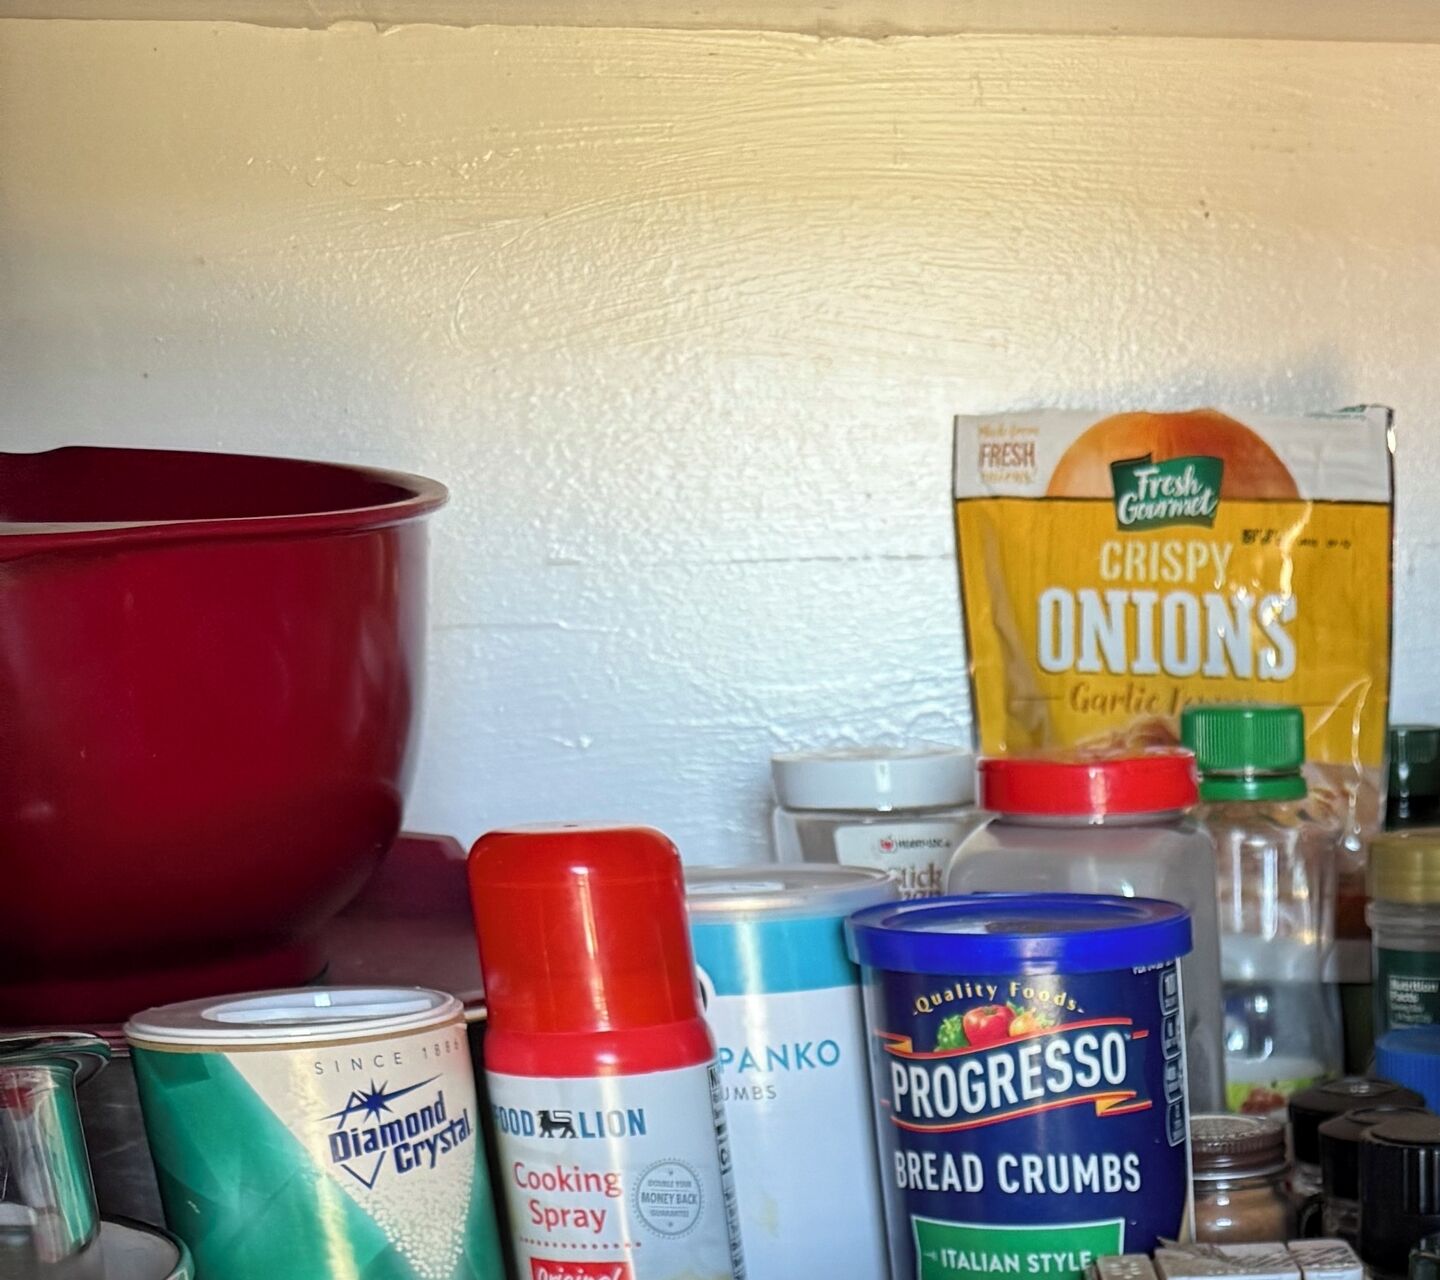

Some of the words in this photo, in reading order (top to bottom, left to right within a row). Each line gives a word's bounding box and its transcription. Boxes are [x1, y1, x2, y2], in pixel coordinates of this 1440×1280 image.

[978, 442, 1036, 468] FRESH
[1134, 464, 1202, 500] Fresh
[1117, 487, 1218, 525] Gourmet
[1100, 540, 1234, 583] CRISPY
[1037, 587, 1298, 681] ONIONS
[916, 982, 998, 1013] Quality
[1010, 981, 1077, 1011] Foods
[314, 1052, 403, 1075] SINCE
[718, 1040, 840, 1074] PANKO
[891, 1031, 1127, 1119] PROGRESSO
[328, 1090, 447, 1164] Diamond
[393, 1108, 471, 1174] Crystal
[581, 1108, 646, 1138] LION
[513, 1161, 622, 1197] Cooking
[895, 1150, 984, 1193] BREAD
[998, 1152, 1141, 1194] CRUMBS
[530, 1199, 607, 1233] Spray
[941, 1248, 1020, 1273] ITALIAN
[1027, 1250, 1092, 1274] STYLE
